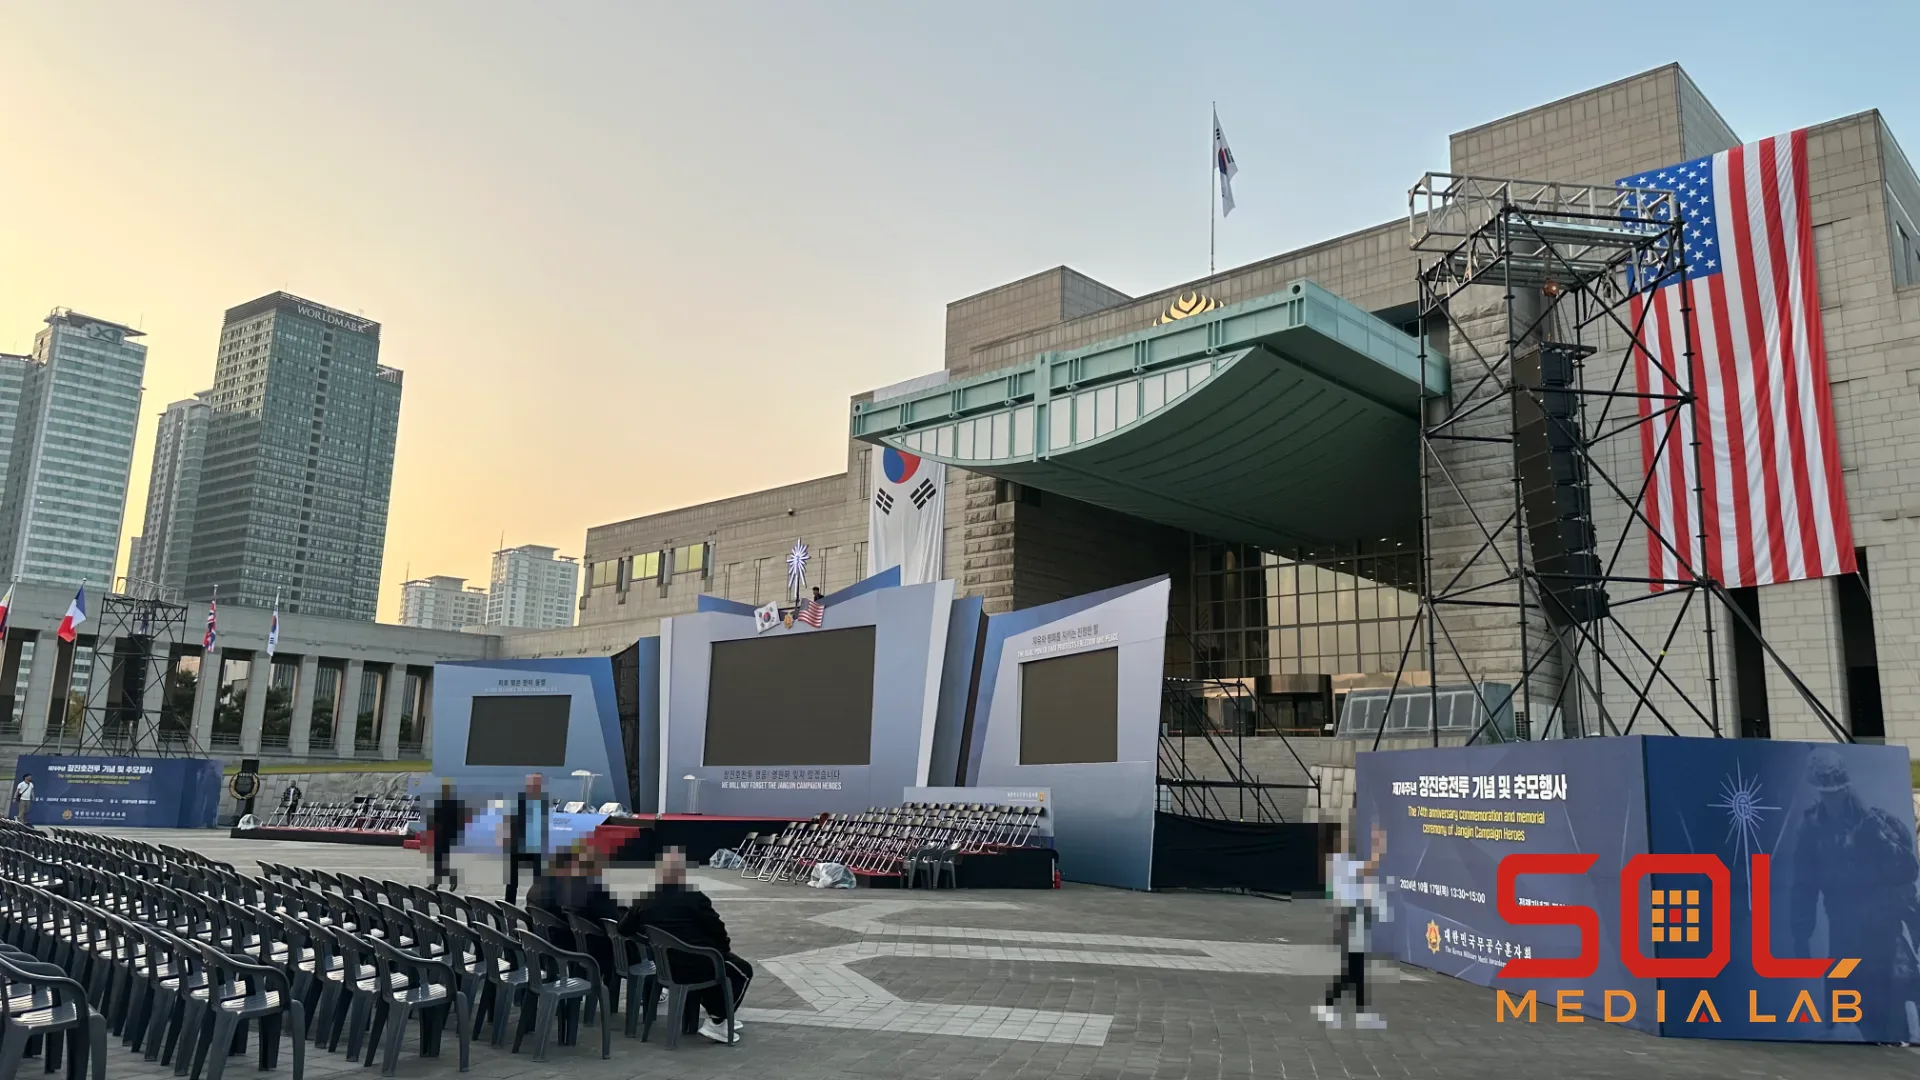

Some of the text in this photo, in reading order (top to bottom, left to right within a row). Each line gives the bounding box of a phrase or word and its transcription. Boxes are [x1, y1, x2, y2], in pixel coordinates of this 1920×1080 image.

[297, 304, 364, 334] WORLDMARK
[807, 769, 840, 780] 않겠습니다
[822, 782, 842, 790] HEROES
[1392, 774, 1567, 800] 제74주년 장진호전투 기념 및 추모행사
[1408, 805, 1545, 824] The 74th anniversary commemoration and memorial
[1423, 824, 1526, 841] ceremony of Jangjin Campaign Heroes
[1400, 878, 1486, 904] 2024년 10월 17일(목) 13:30~15:00
[1444, 928, 1532, 959] 대한민국무공수훈자회
